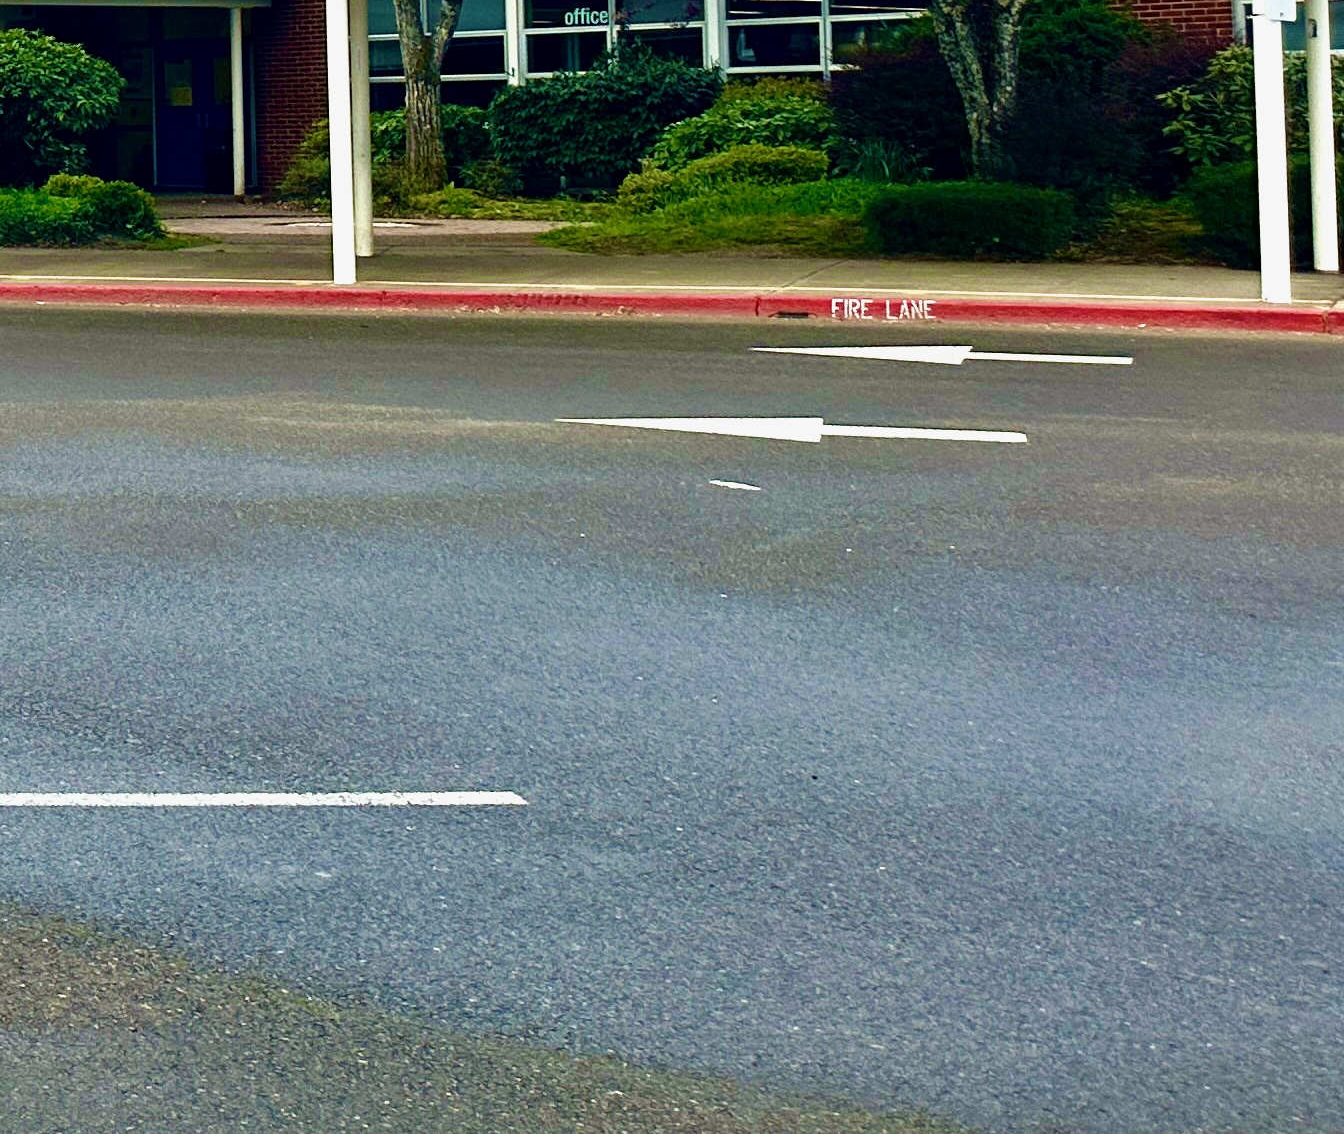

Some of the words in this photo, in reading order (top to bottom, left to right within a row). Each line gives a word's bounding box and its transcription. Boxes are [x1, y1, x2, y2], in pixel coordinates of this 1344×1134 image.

[564, 7, 609, 25] office
[831, 298, 873, 320] FIRE
[885, 299, 937, 320] LANE
